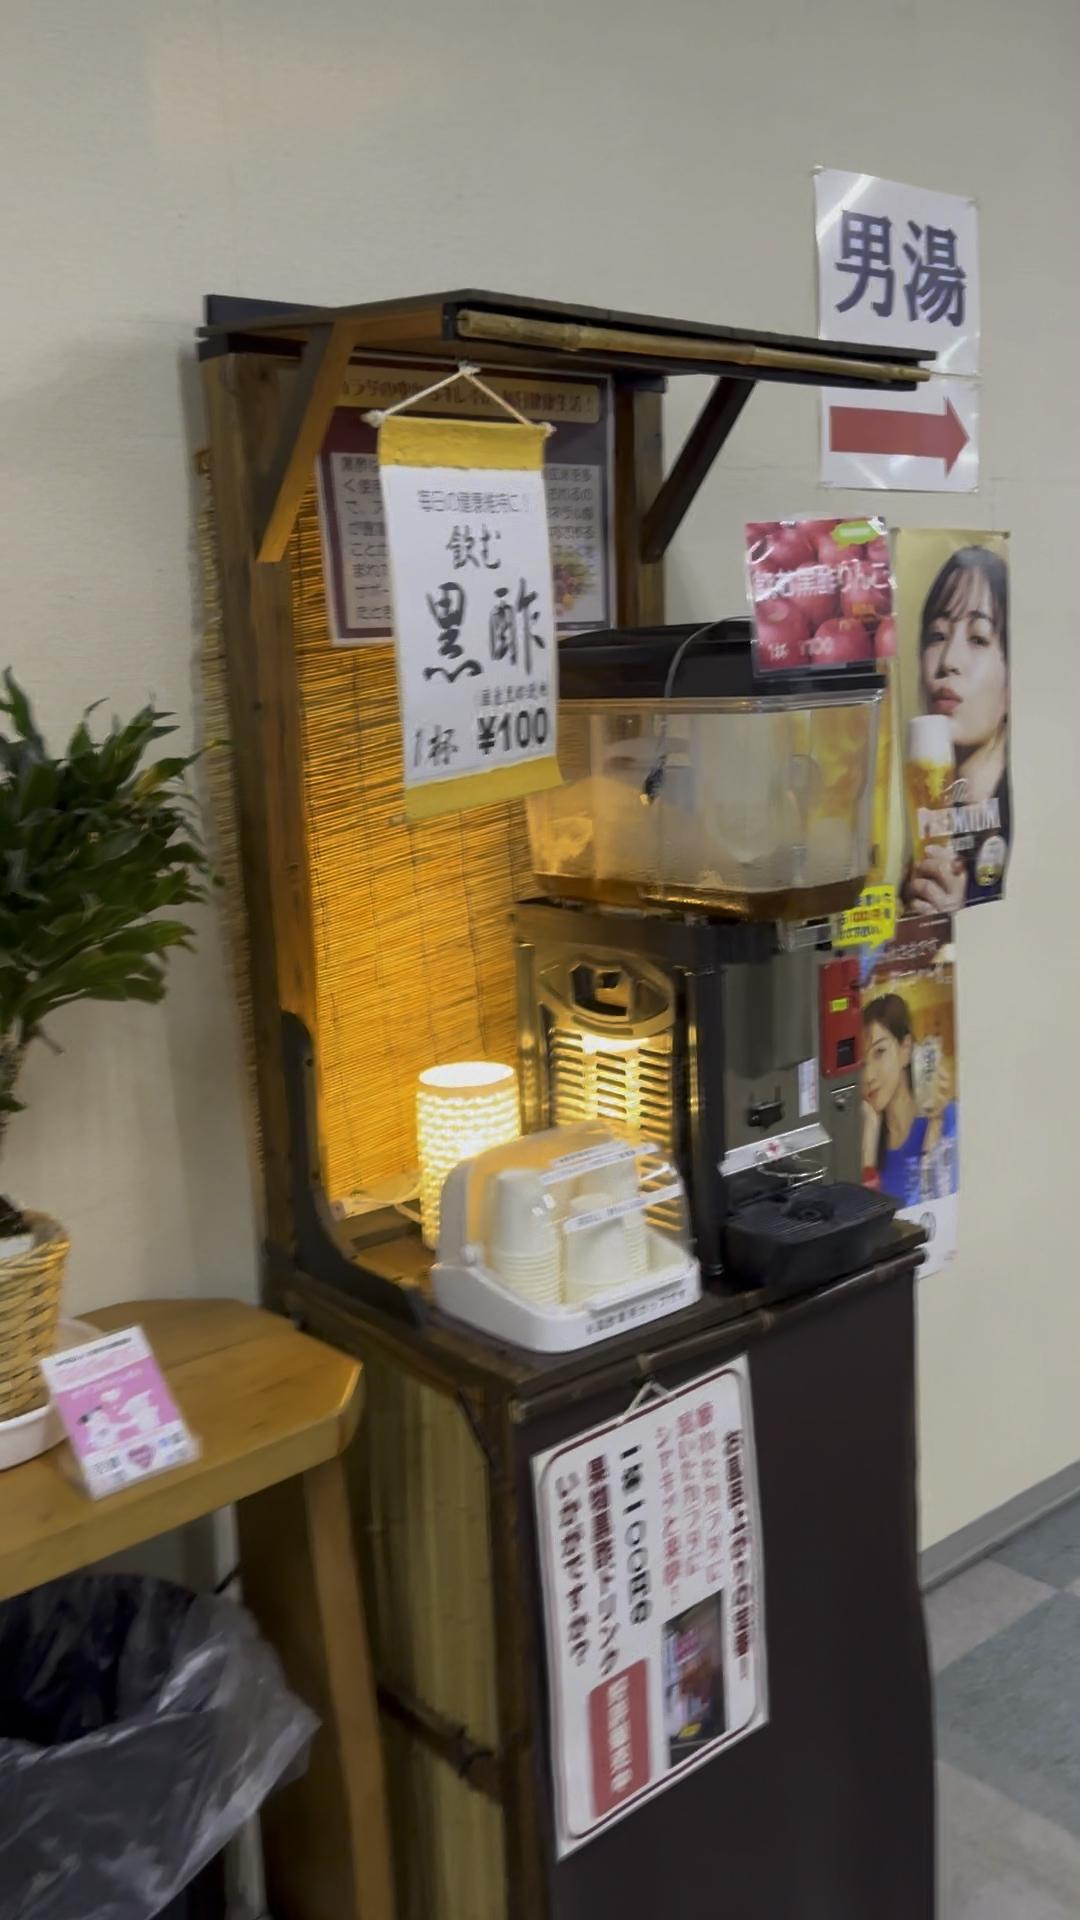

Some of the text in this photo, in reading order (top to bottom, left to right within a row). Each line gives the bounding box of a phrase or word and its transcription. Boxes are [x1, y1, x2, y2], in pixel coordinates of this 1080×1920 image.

[835, 208, 967, 327] 男湯
[446, 523, 502, 570] 飲む
[423, 576, 546, 683] 黒酢
[477, 706, 549, 756] ¥100
